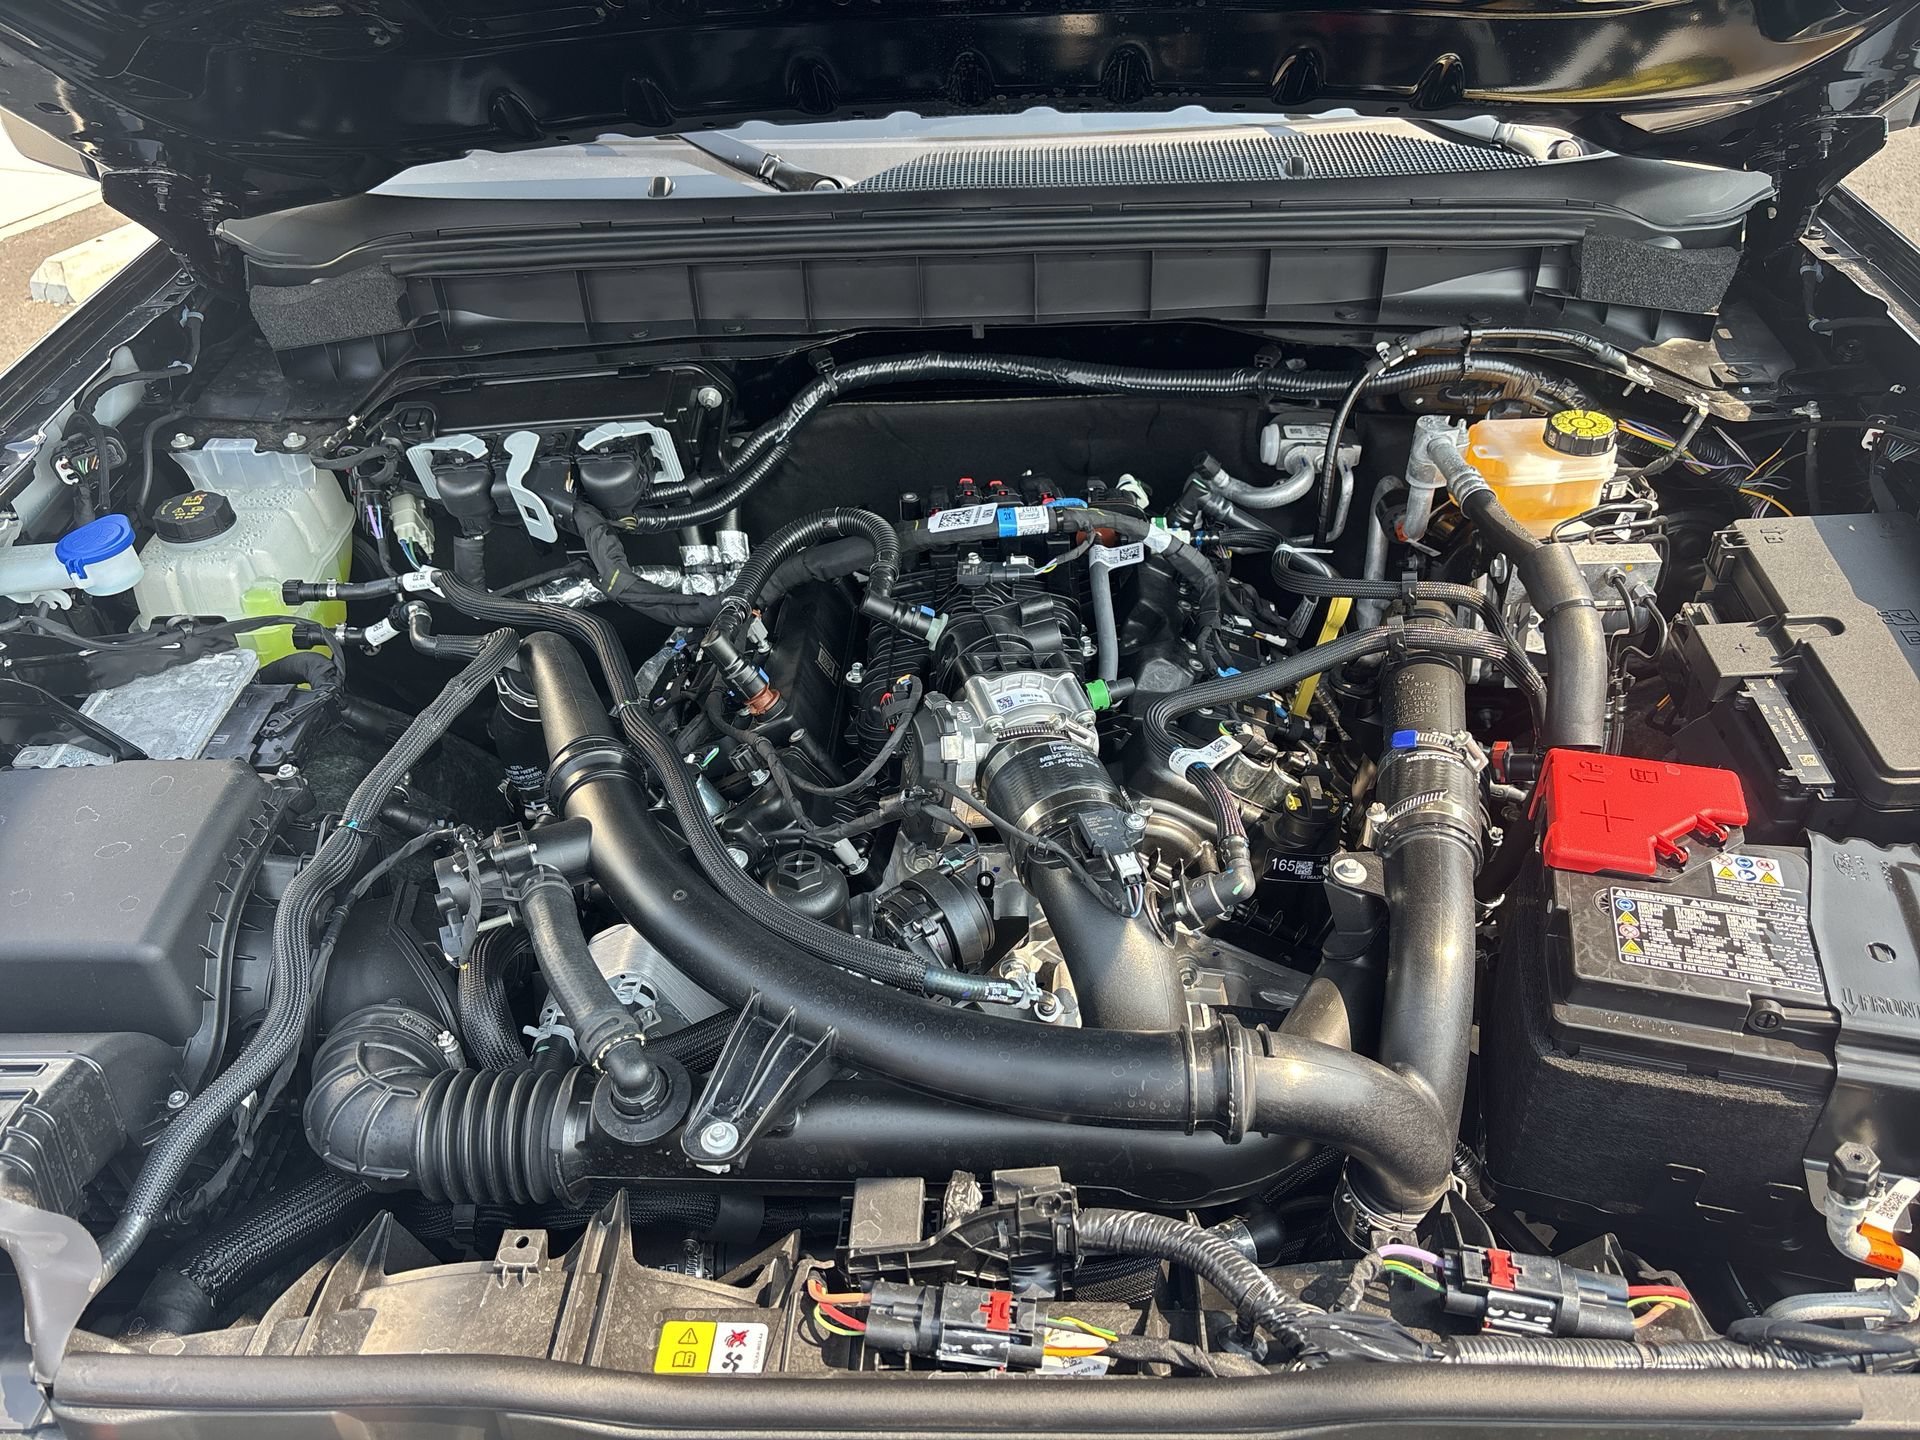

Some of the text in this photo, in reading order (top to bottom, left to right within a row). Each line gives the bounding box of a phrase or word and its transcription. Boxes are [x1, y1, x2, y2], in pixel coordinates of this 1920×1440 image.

[1272, 858, 1296, 872] 165
[1625, 891, 1683, 905] DANGER/POISON
[1683, 964, 1697, 972] PAS
[1740, 972, 1750, 980] LA
